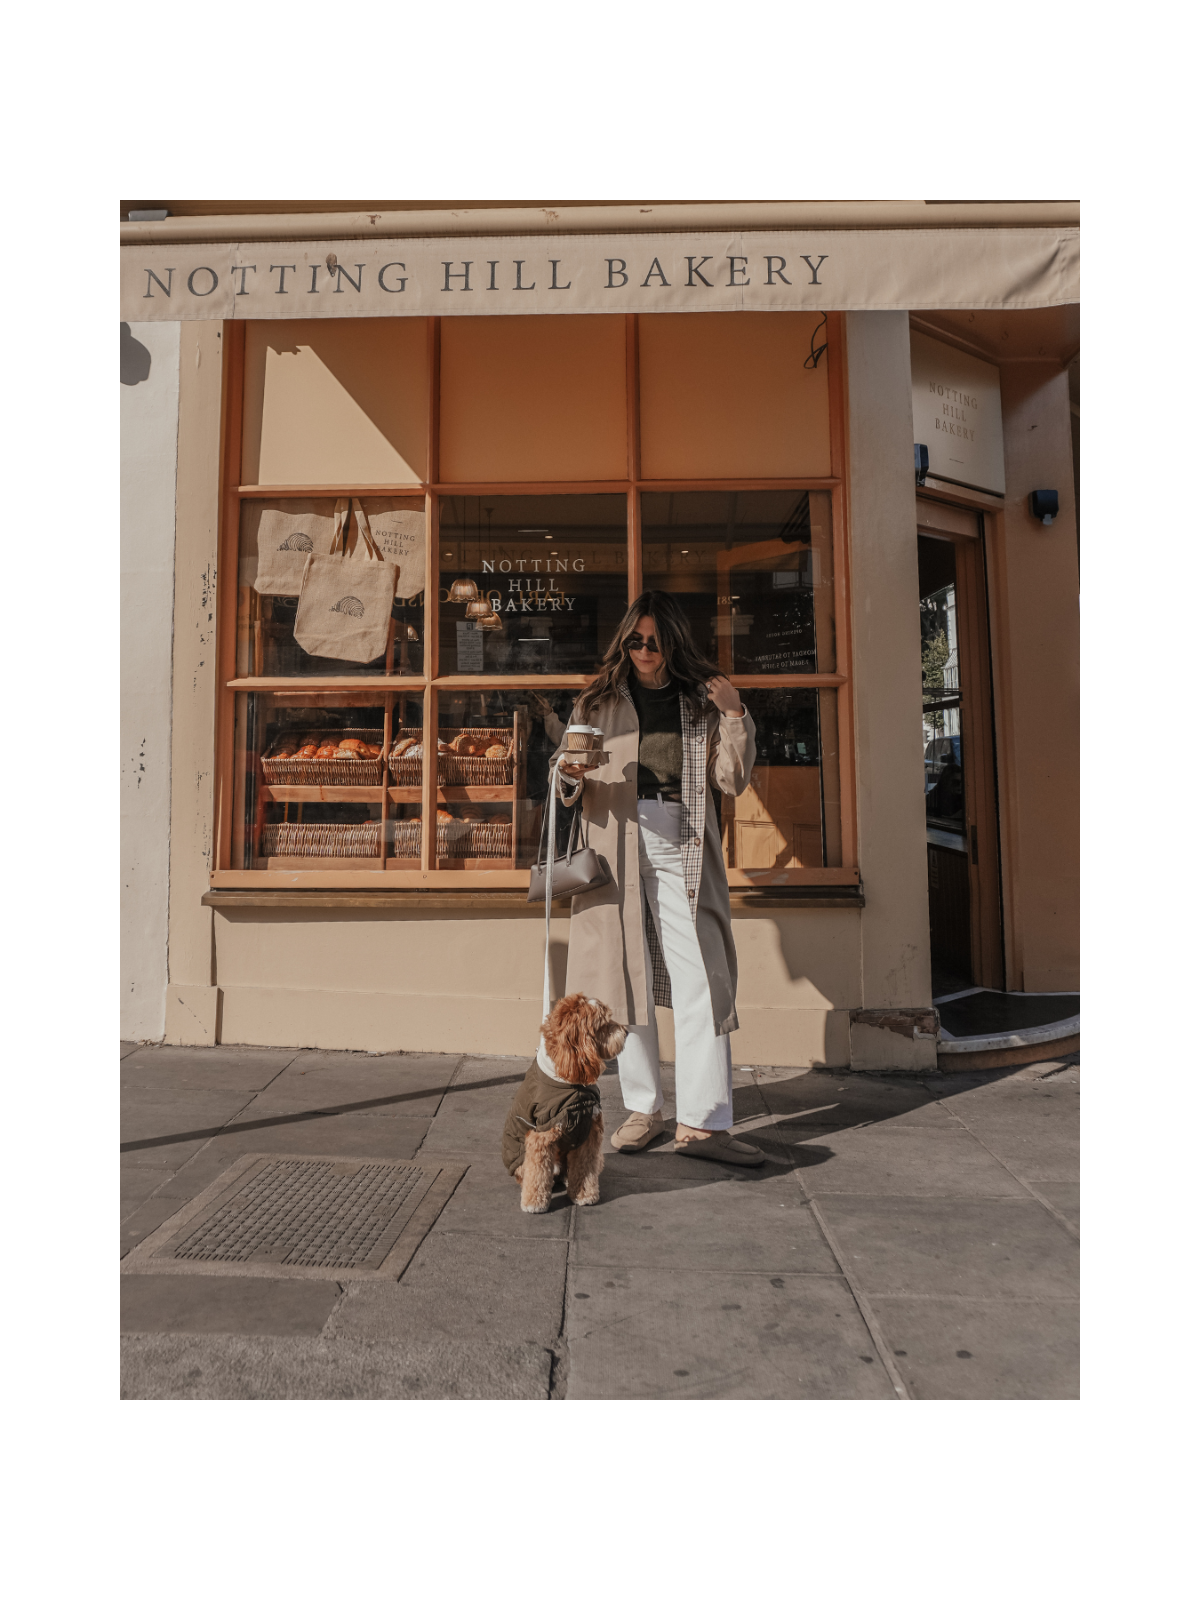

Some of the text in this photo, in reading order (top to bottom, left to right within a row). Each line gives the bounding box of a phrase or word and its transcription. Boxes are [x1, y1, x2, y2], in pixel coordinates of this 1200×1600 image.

[143, 255, 829, 298] NOTTING HILL BAKERY
[929, 381, 978, 410] NOTTING
[942, 403, 967, 422] HILL
[935, 417, 975, 442] BAKERY
[375, 529, 415, 542] NOTTING
[383, 538, 404, 548] HILL
[615, 549, 706, 564] BKERY
[481, 558, 586, 574] NOTTING
[508, 578, 559, 593] HILL
[491, 597, 576, 612] BAKERY
